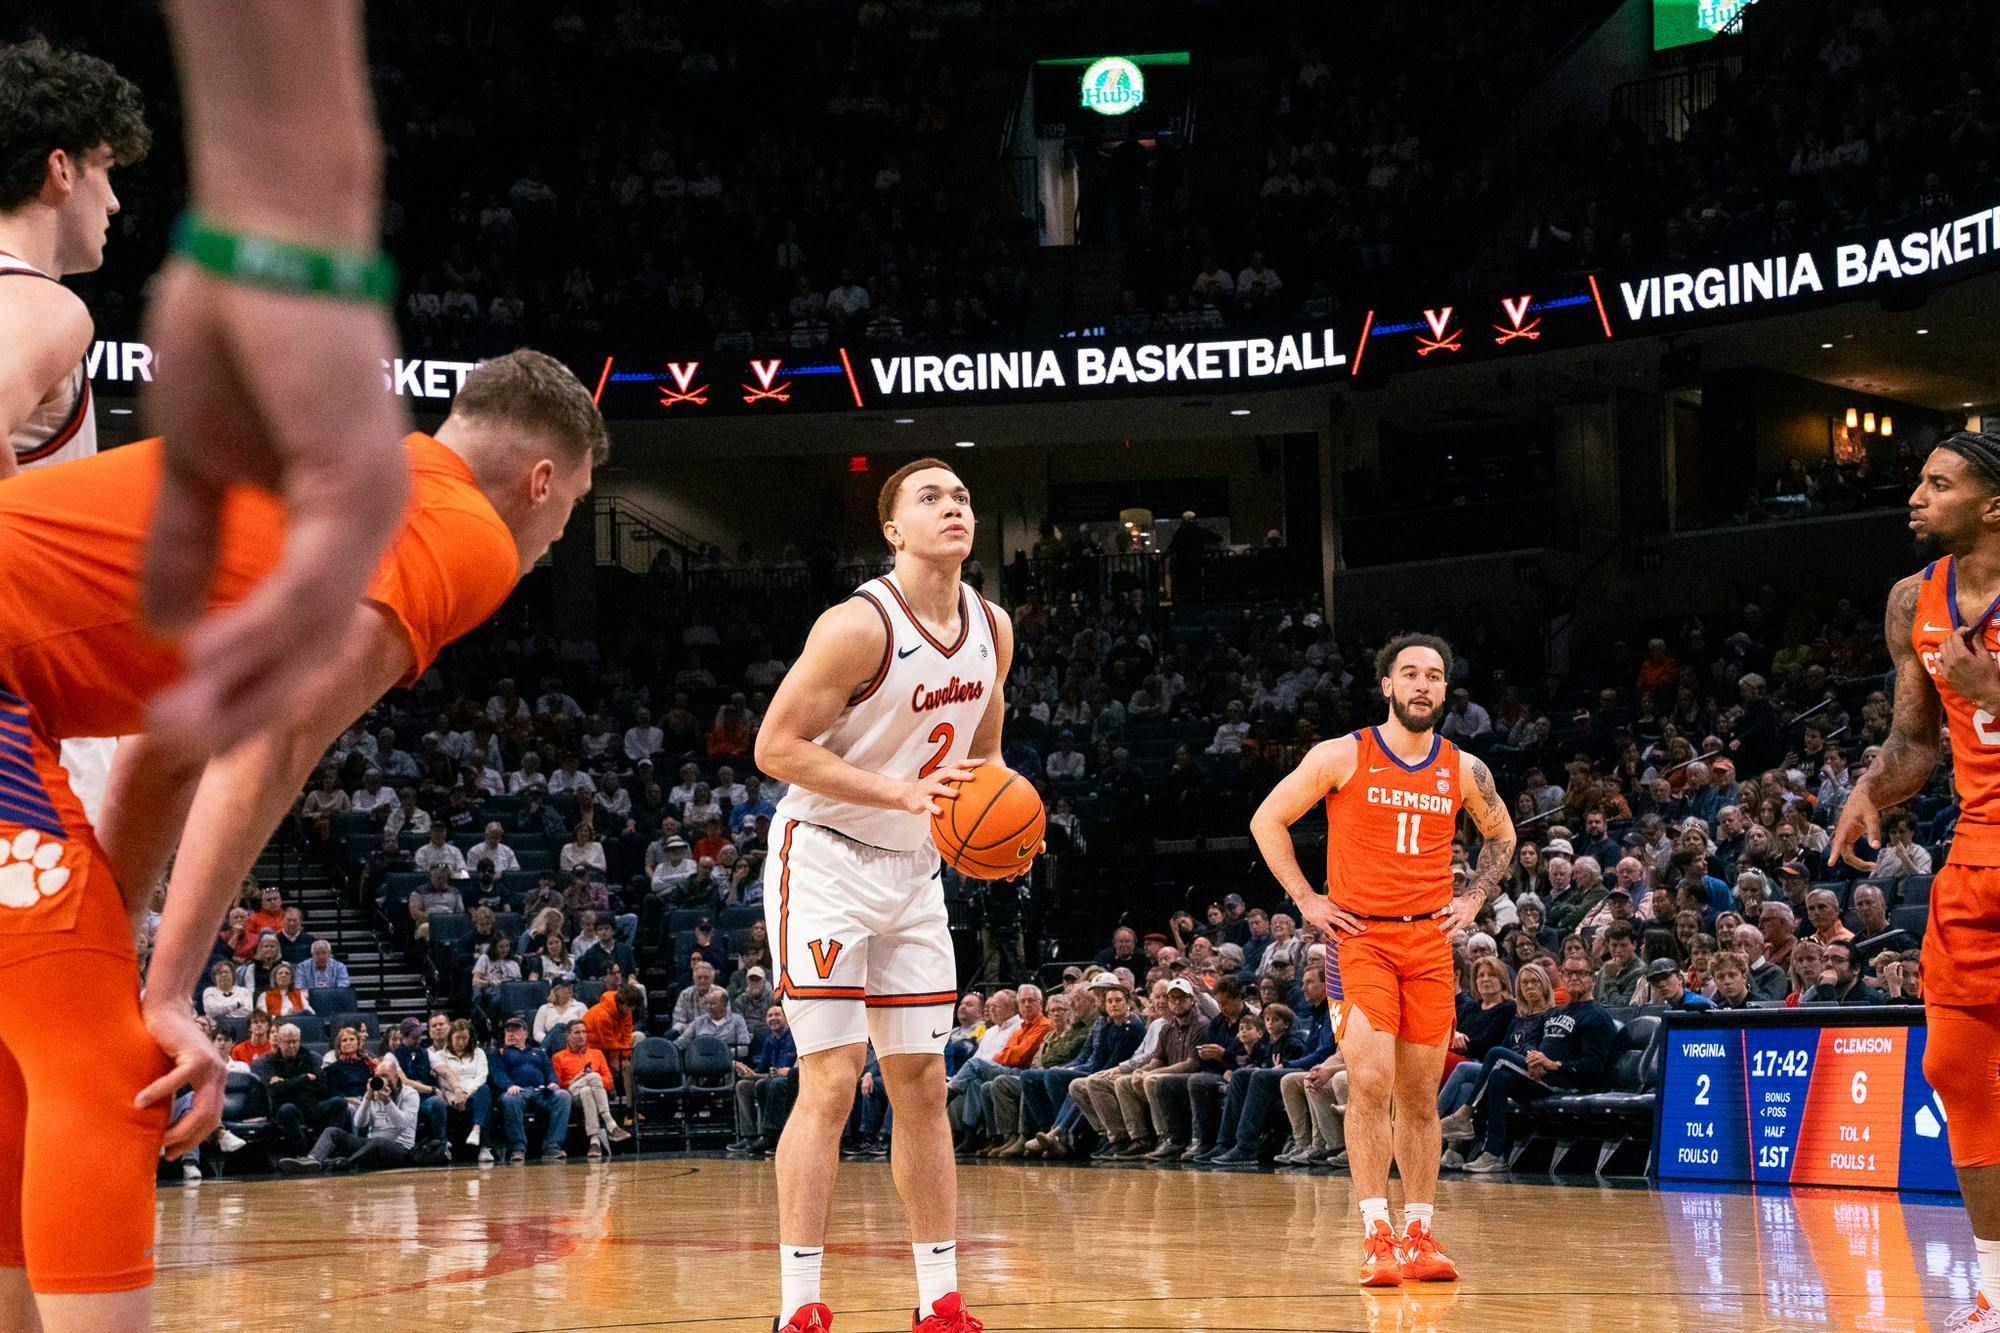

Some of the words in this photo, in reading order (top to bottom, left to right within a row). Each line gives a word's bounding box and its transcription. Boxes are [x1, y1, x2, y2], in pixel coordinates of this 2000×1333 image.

[1085, 86, 1141, 105] Hubs
[1619, 252, 1824, 321] VIRGINIA
[86, 340, 160, 382] VIR
[871, 350, 1066, 394] VIRGINIA
[1077, 328, 1347, 385] BASKETBALL
[912, 676, 984, 713] Cavaliers
[918, 722, 955, 780] 2
[1367, 786, 1453, 815] CLEMSON
[1396, 812, 1422, 855] 11
[807, 938, 844, 979] V
[1682, 1043, 1726, 1058] VIRGINIA
[1833, 1036, 1893, 1054] CLEMSON
[1751, 1050, 1809, 1077] 17:42
[1694, 1074, 1711, 1106] 2
[1765, 1092, 1791, 1103] BONUS
[1850, 1070, 1868, 1104] 6
[1767, 1106, 1787, 1118] POSS
[1686, 1122, 1704, 1137] TOL
[1705, 1122, 1714, 1138] 4
[1764, 1126, 1786, 1138] HALF
[1839, 1125, 1860, 1142] TOL
[1861, 1126, 1870, 1142] 4
[1678, 1148, 1709, 1164] FOULS
[1710, 1149, 1719, 1164] 0
[1758, 1145, 1789, 1168] 1ST
[1830, 1153, 1865, 1170] FOULS
[1867, 1154, 1876, 1171] 1
